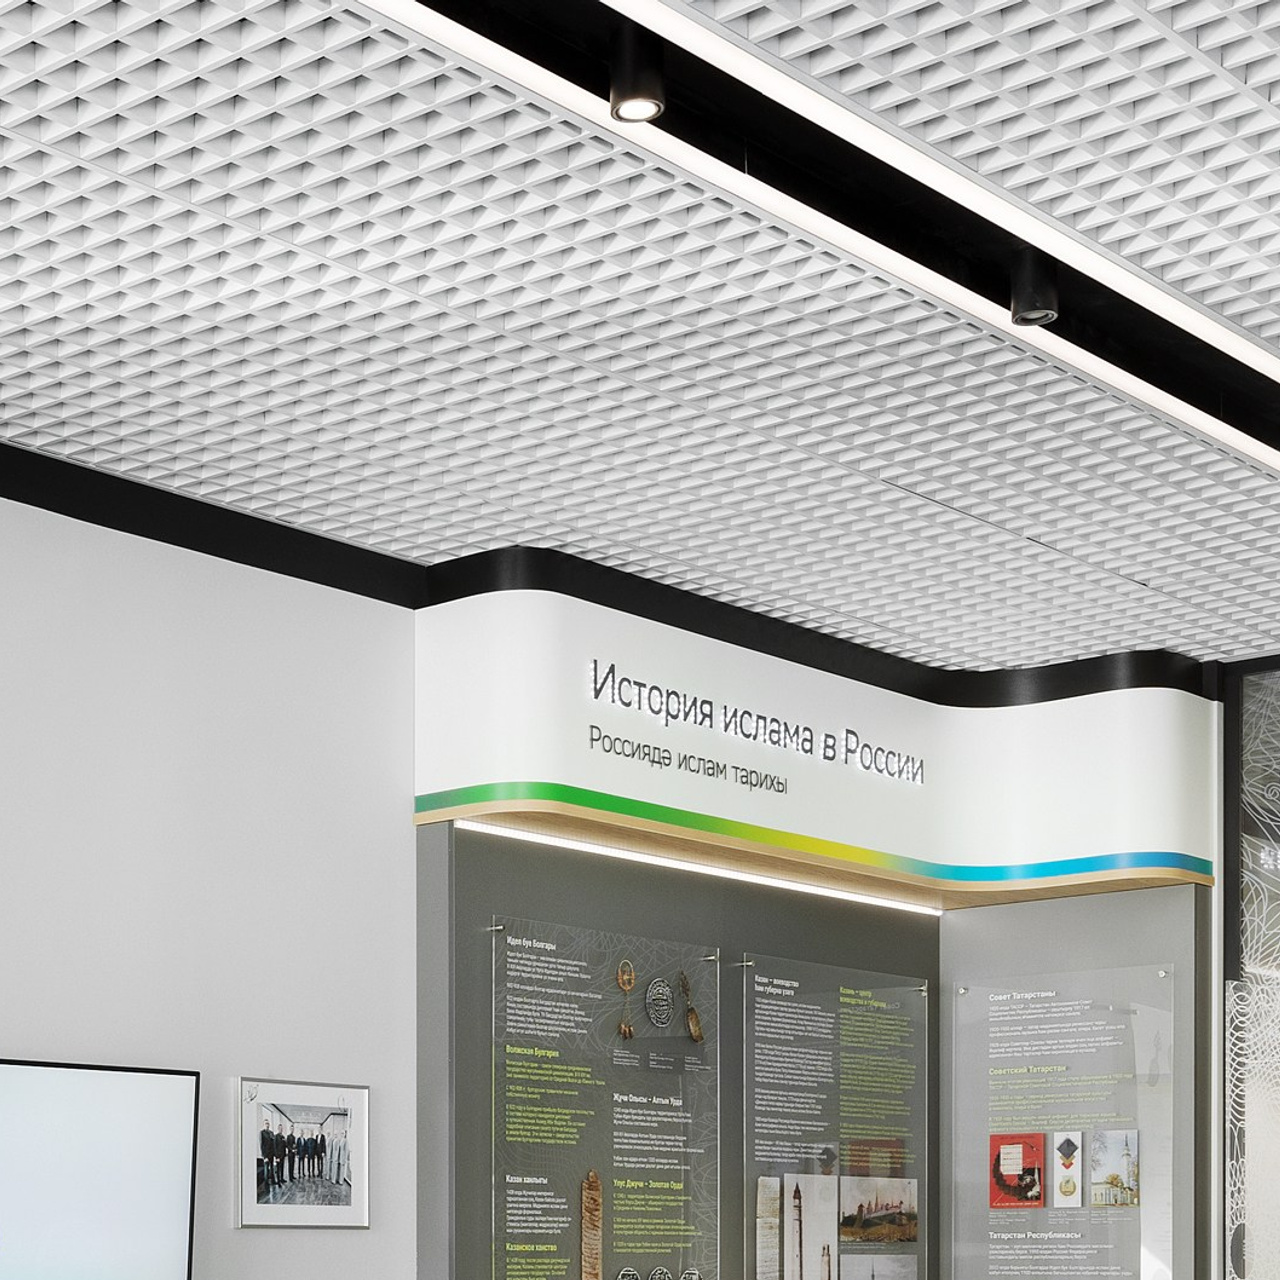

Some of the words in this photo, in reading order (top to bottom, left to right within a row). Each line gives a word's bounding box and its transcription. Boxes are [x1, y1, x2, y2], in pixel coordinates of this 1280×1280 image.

[592, 659, 714, 727] История
[723, 704, 813, 755] ислама
[823, 734, 836, 761] в
[844, 728, 924, 784] России
[589, 724, 672, 767] Россиядә
[678, 752, 727, 780] ислам
[732, 765, 787, 794] тарихы
[1027, 1232, 1081, 1240] Республикасы
